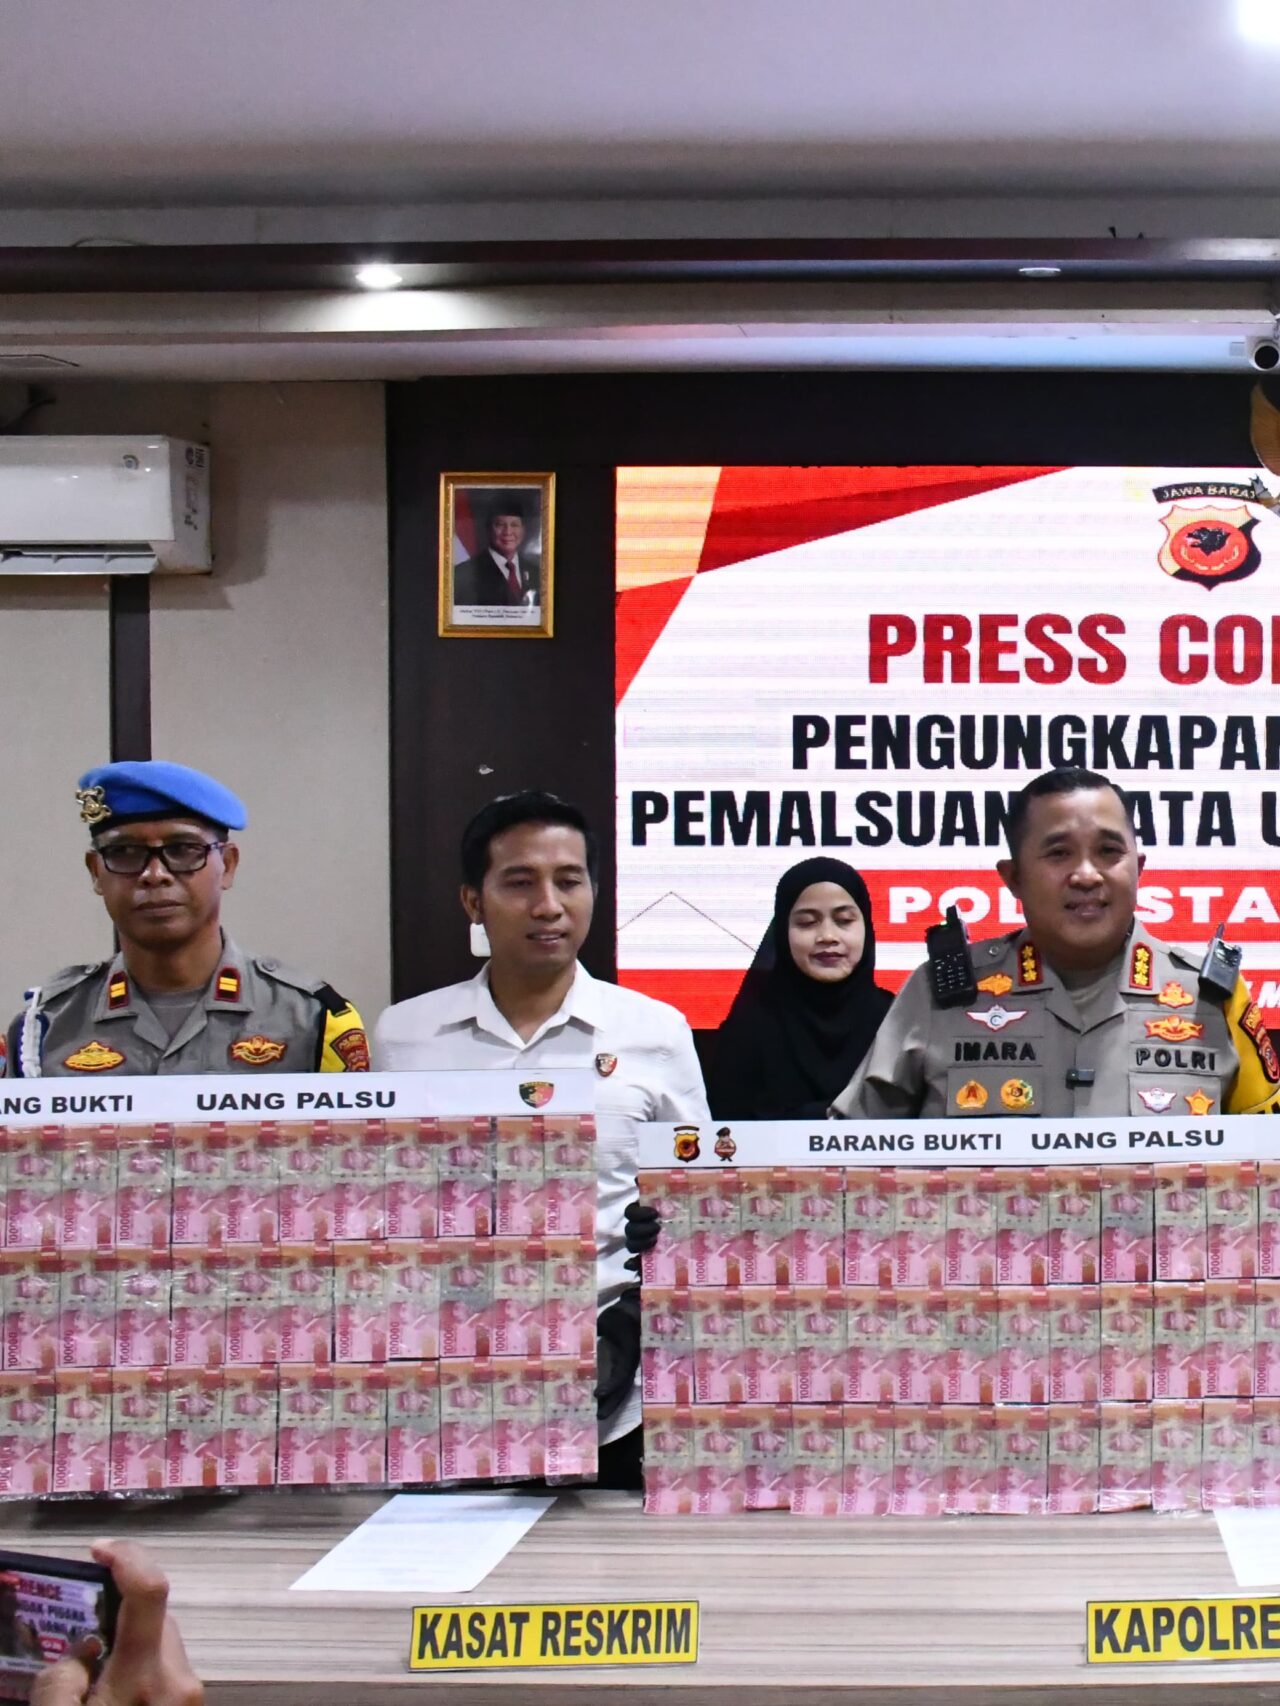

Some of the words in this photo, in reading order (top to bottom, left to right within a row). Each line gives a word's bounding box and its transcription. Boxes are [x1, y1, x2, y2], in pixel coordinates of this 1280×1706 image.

[1163, 485, 1203, 499] JAWA
[869, 613, 1127, 685] PRESS
[631, 790, 1016, 847] PEMALSUAN
[1123, 790, 1236, 846] ATA
[888, 885, 1280, 924] POLSTA
[955, 1042, 1036, 1062] IMARA
[1136, 1048, 1216, 1071] POLRI
[51, 1095, 133, 1114] BUKTI
[196, 1092, 285, 1111] UANG
[297, 1091, 396, 1109] PALSU
[809, 1134, 915, 1152] BARANG
[924, 1133, 1001, 1151] BUKTI
[1031, 1131, 1117, 1151] UANG
[1128, 1129, 1225, 1149] PALSU
[417, 1611, 530, 1660] KASAT
[540, 1608, 691, 1657] RESKRIM
